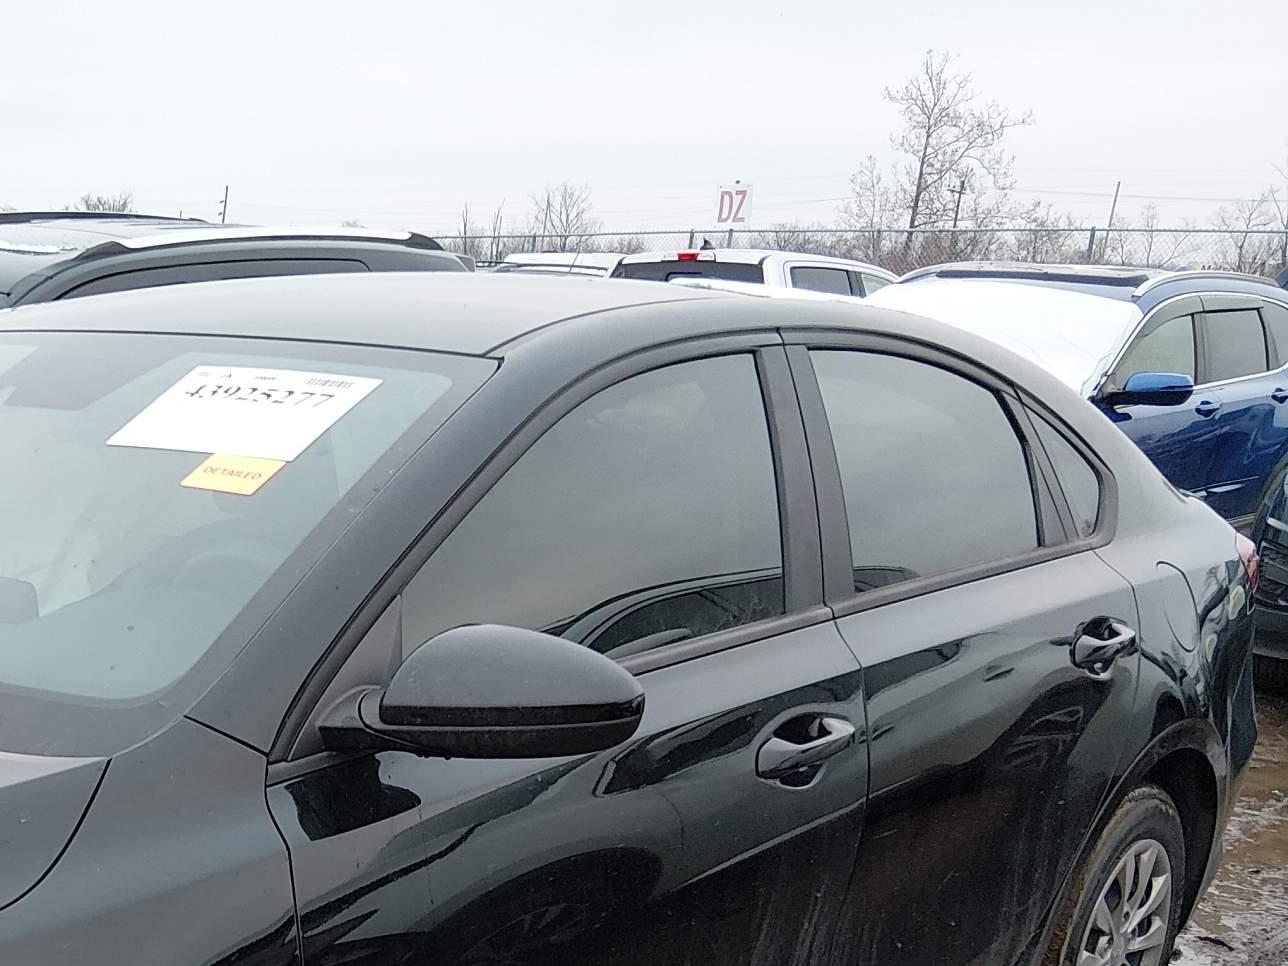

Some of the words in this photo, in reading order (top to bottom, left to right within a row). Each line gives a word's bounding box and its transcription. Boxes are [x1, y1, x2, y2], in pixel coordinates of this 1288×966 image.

[716, 189, 748, 223] DZ
[185, 384, 336, 408] 43925277
[202, 465, 263, 481] DETAILED
